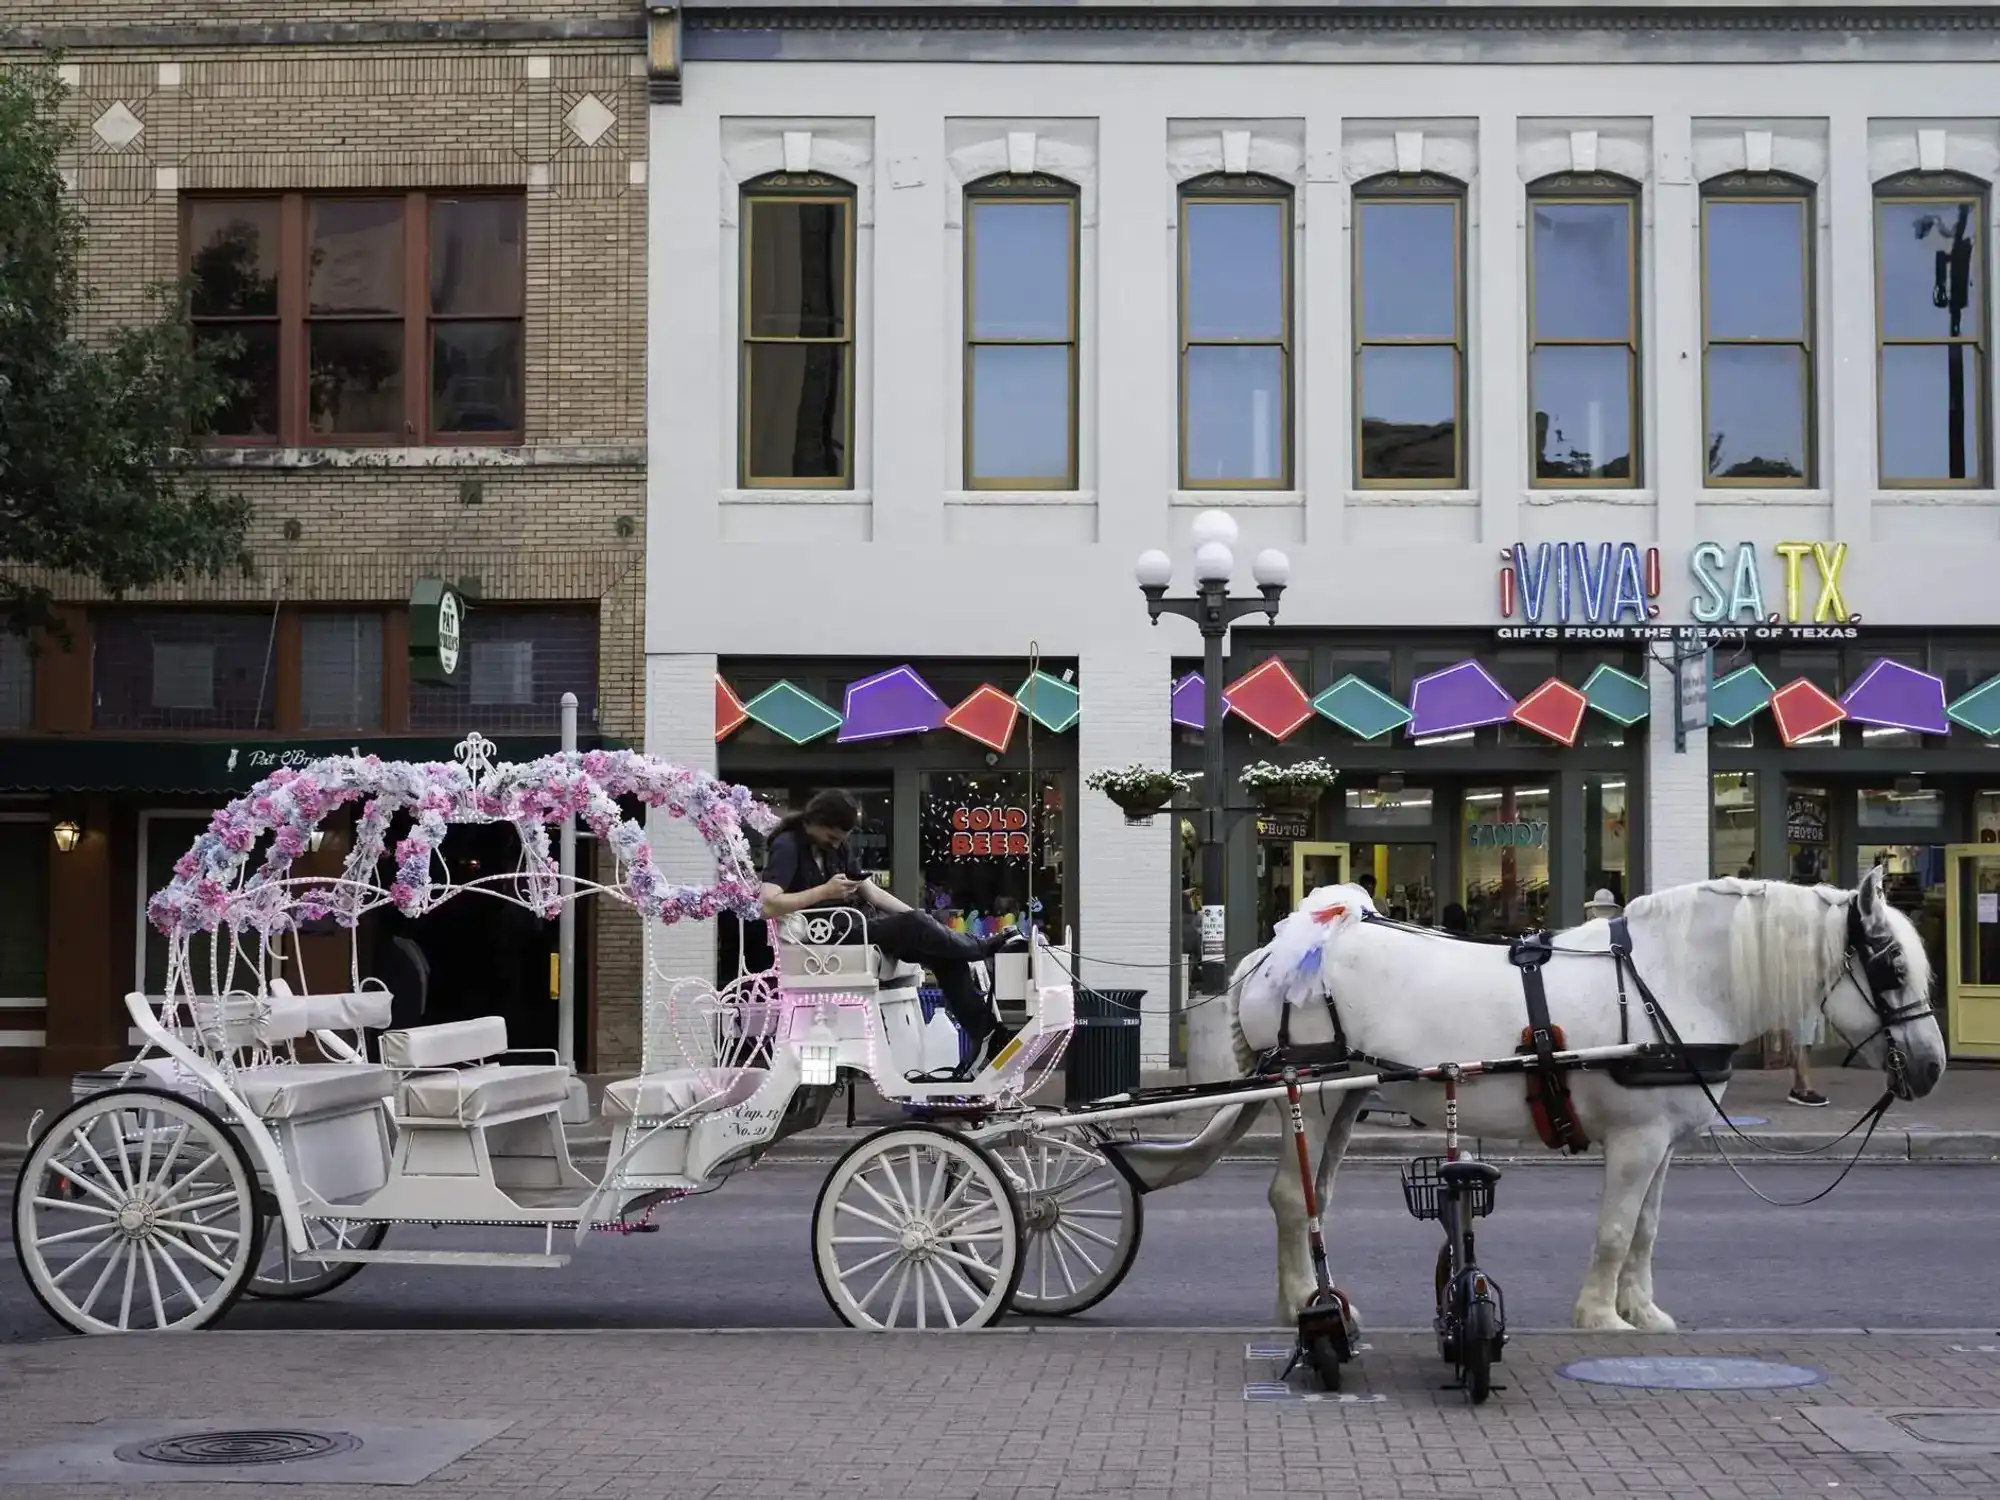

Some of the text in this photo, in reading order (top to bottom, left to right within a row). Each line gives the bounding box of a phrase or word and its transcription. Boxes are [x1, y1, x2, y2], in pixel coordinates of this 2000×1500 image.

[442, 611, 454, 633] PAT
[1498, 627, 1857, 638] GIFTS FROM THE HEART OF TEXAS
[248, 750, 275, 766] Pat
[953, 807, 1027, 830] COLD
[952, 832, 1029, 856] BEER
[1467, 822, 1549, 848] CANDY
[1788, 826, 1824, 840] PHOTOS
